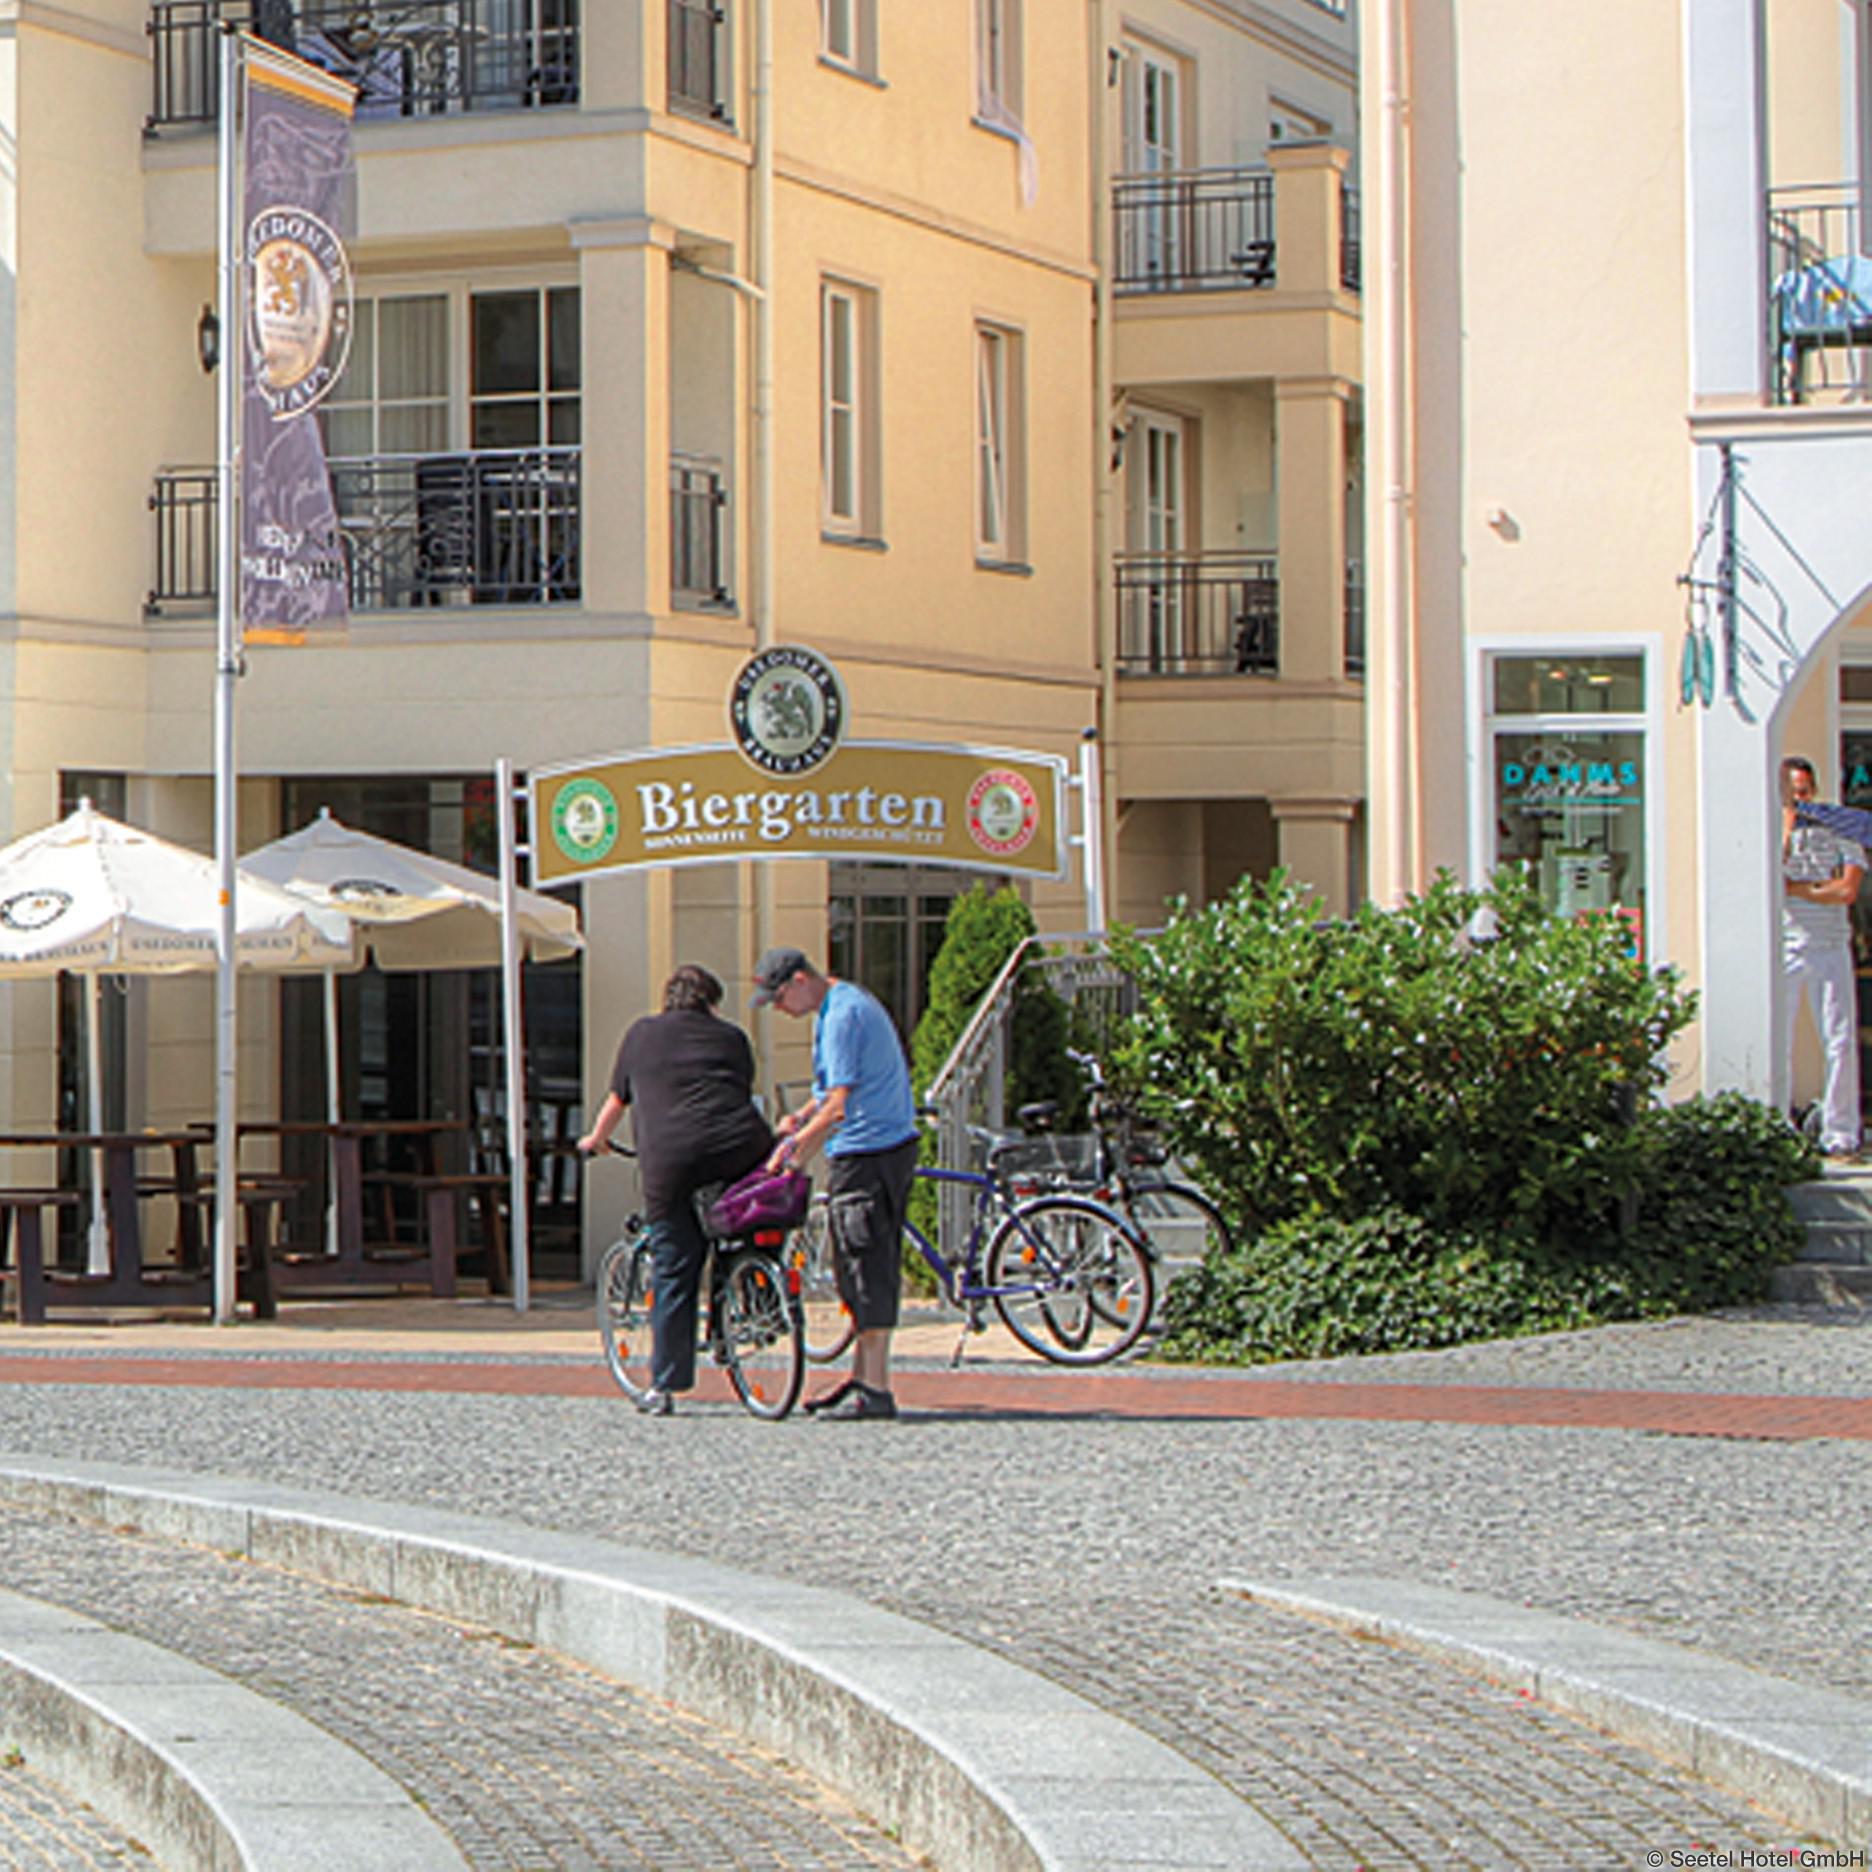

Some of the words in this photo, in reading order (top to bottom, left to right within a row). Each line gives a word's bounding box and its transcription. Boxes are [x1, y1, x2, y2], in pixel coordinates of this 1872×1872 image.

[738, 650, 831, 690] USEDOMER
[743, 734, 832, 771] BRAUHAUS
[1503, 761, 1639, 786] DAHMS
[635, 780, 946, 842] Biergarten
